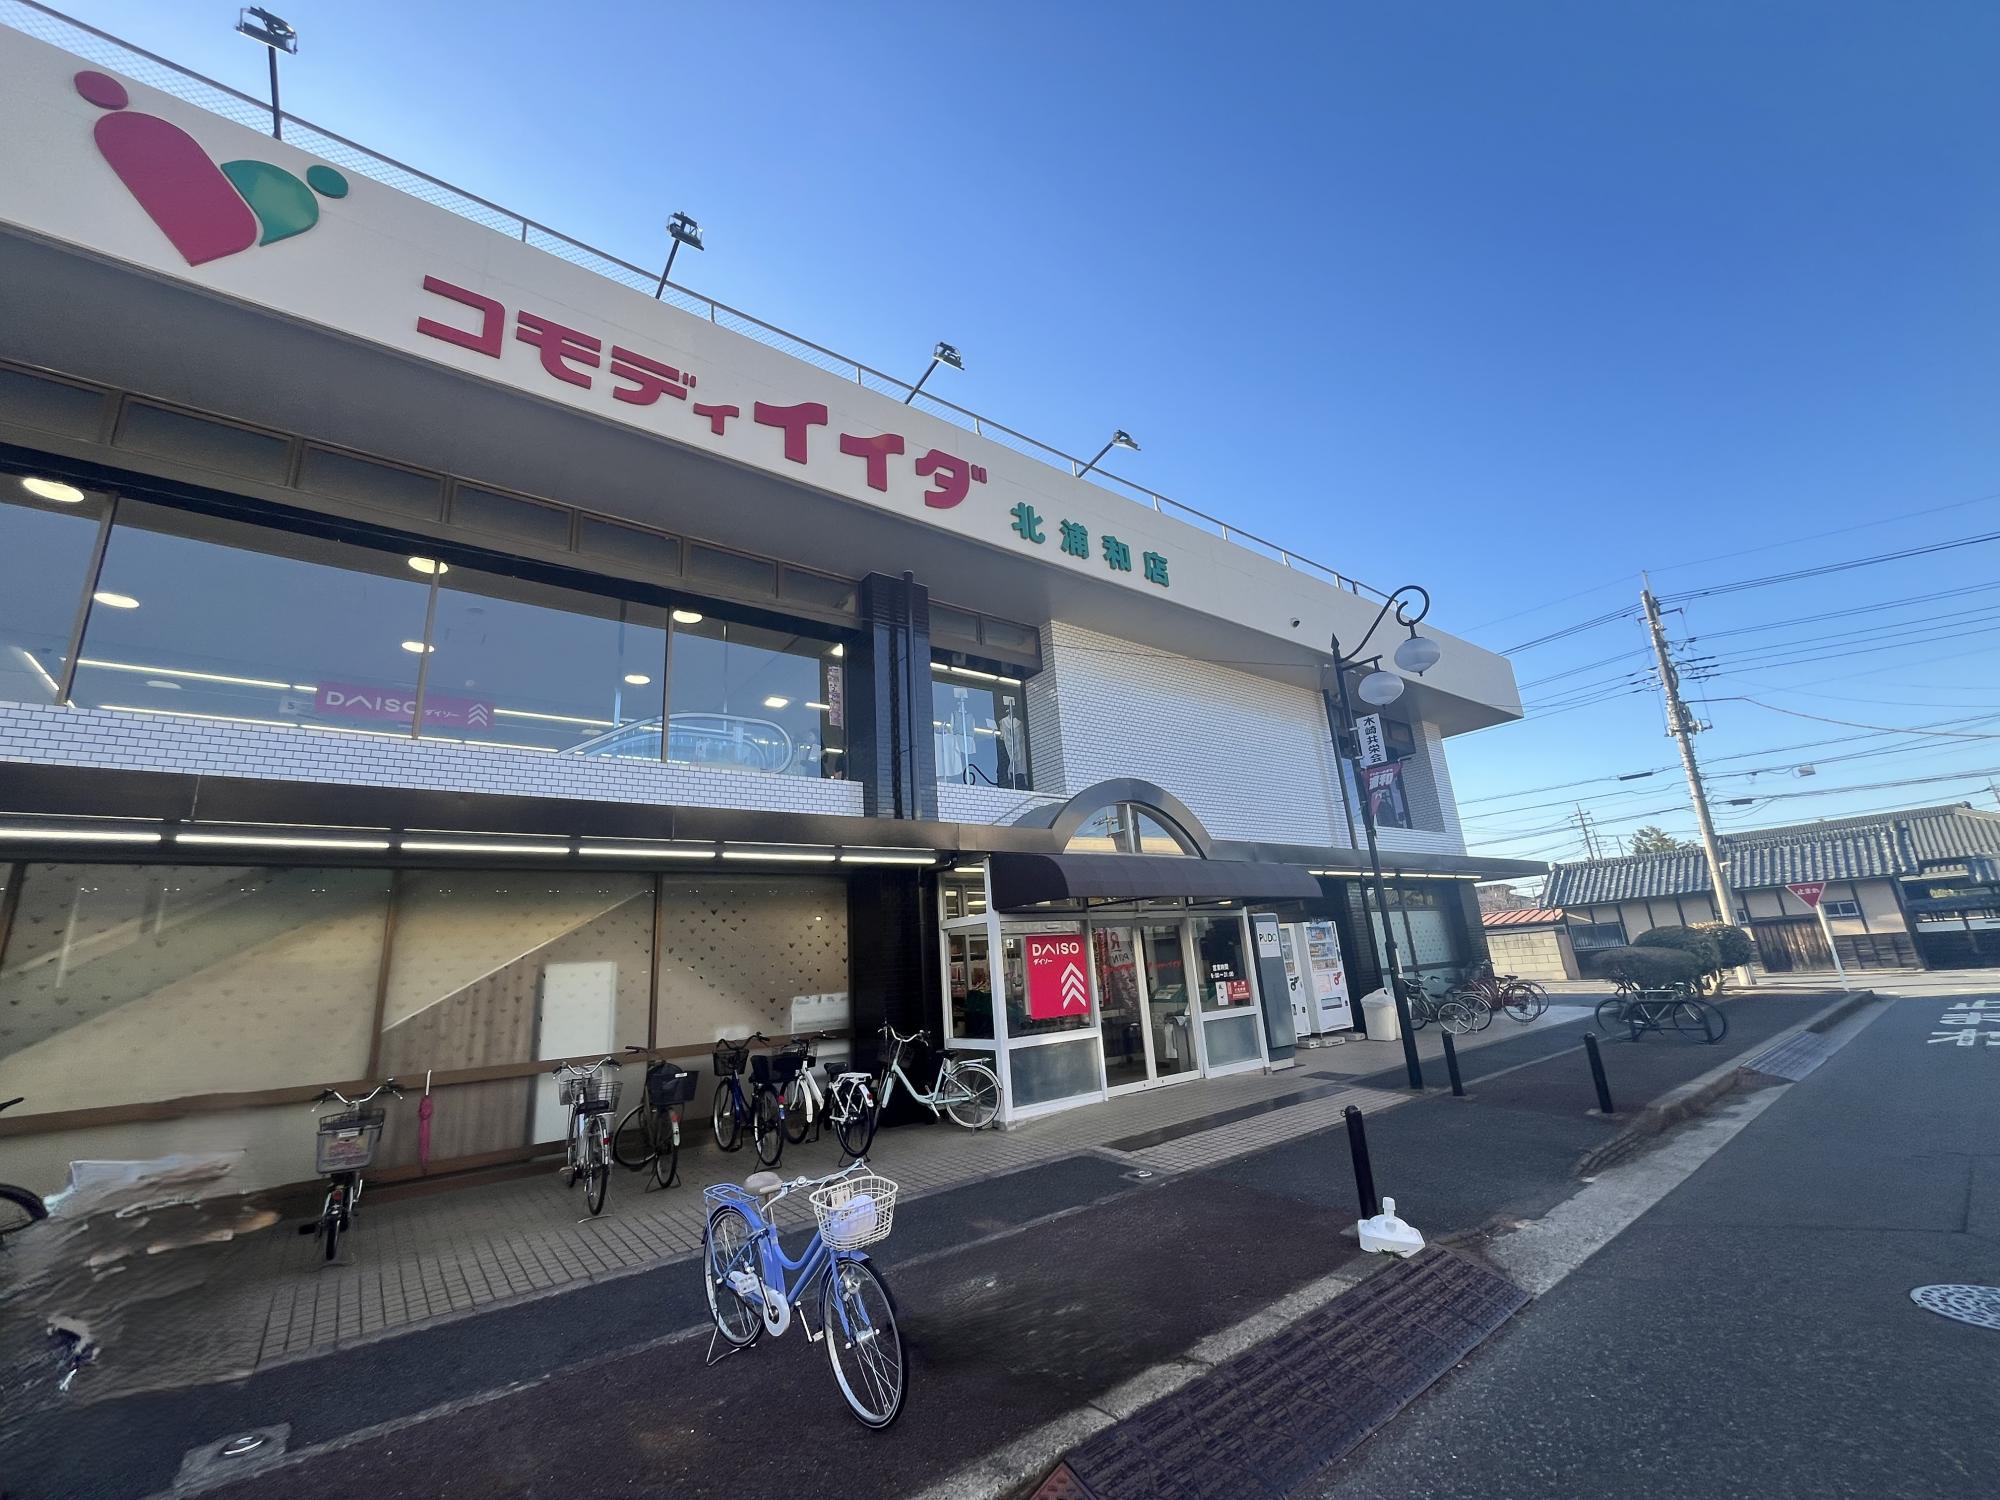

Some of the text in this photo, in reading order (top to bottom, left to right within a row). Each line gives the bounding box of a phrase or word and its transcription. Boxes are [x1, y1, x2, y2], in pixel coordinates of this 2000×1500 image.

[416, 274, 1169, 588] コモディイイダ 北浦和店
[1363, 717, 1383, 763] 木崎共栄会
[1032, 942, 1079, 957] DAISO
